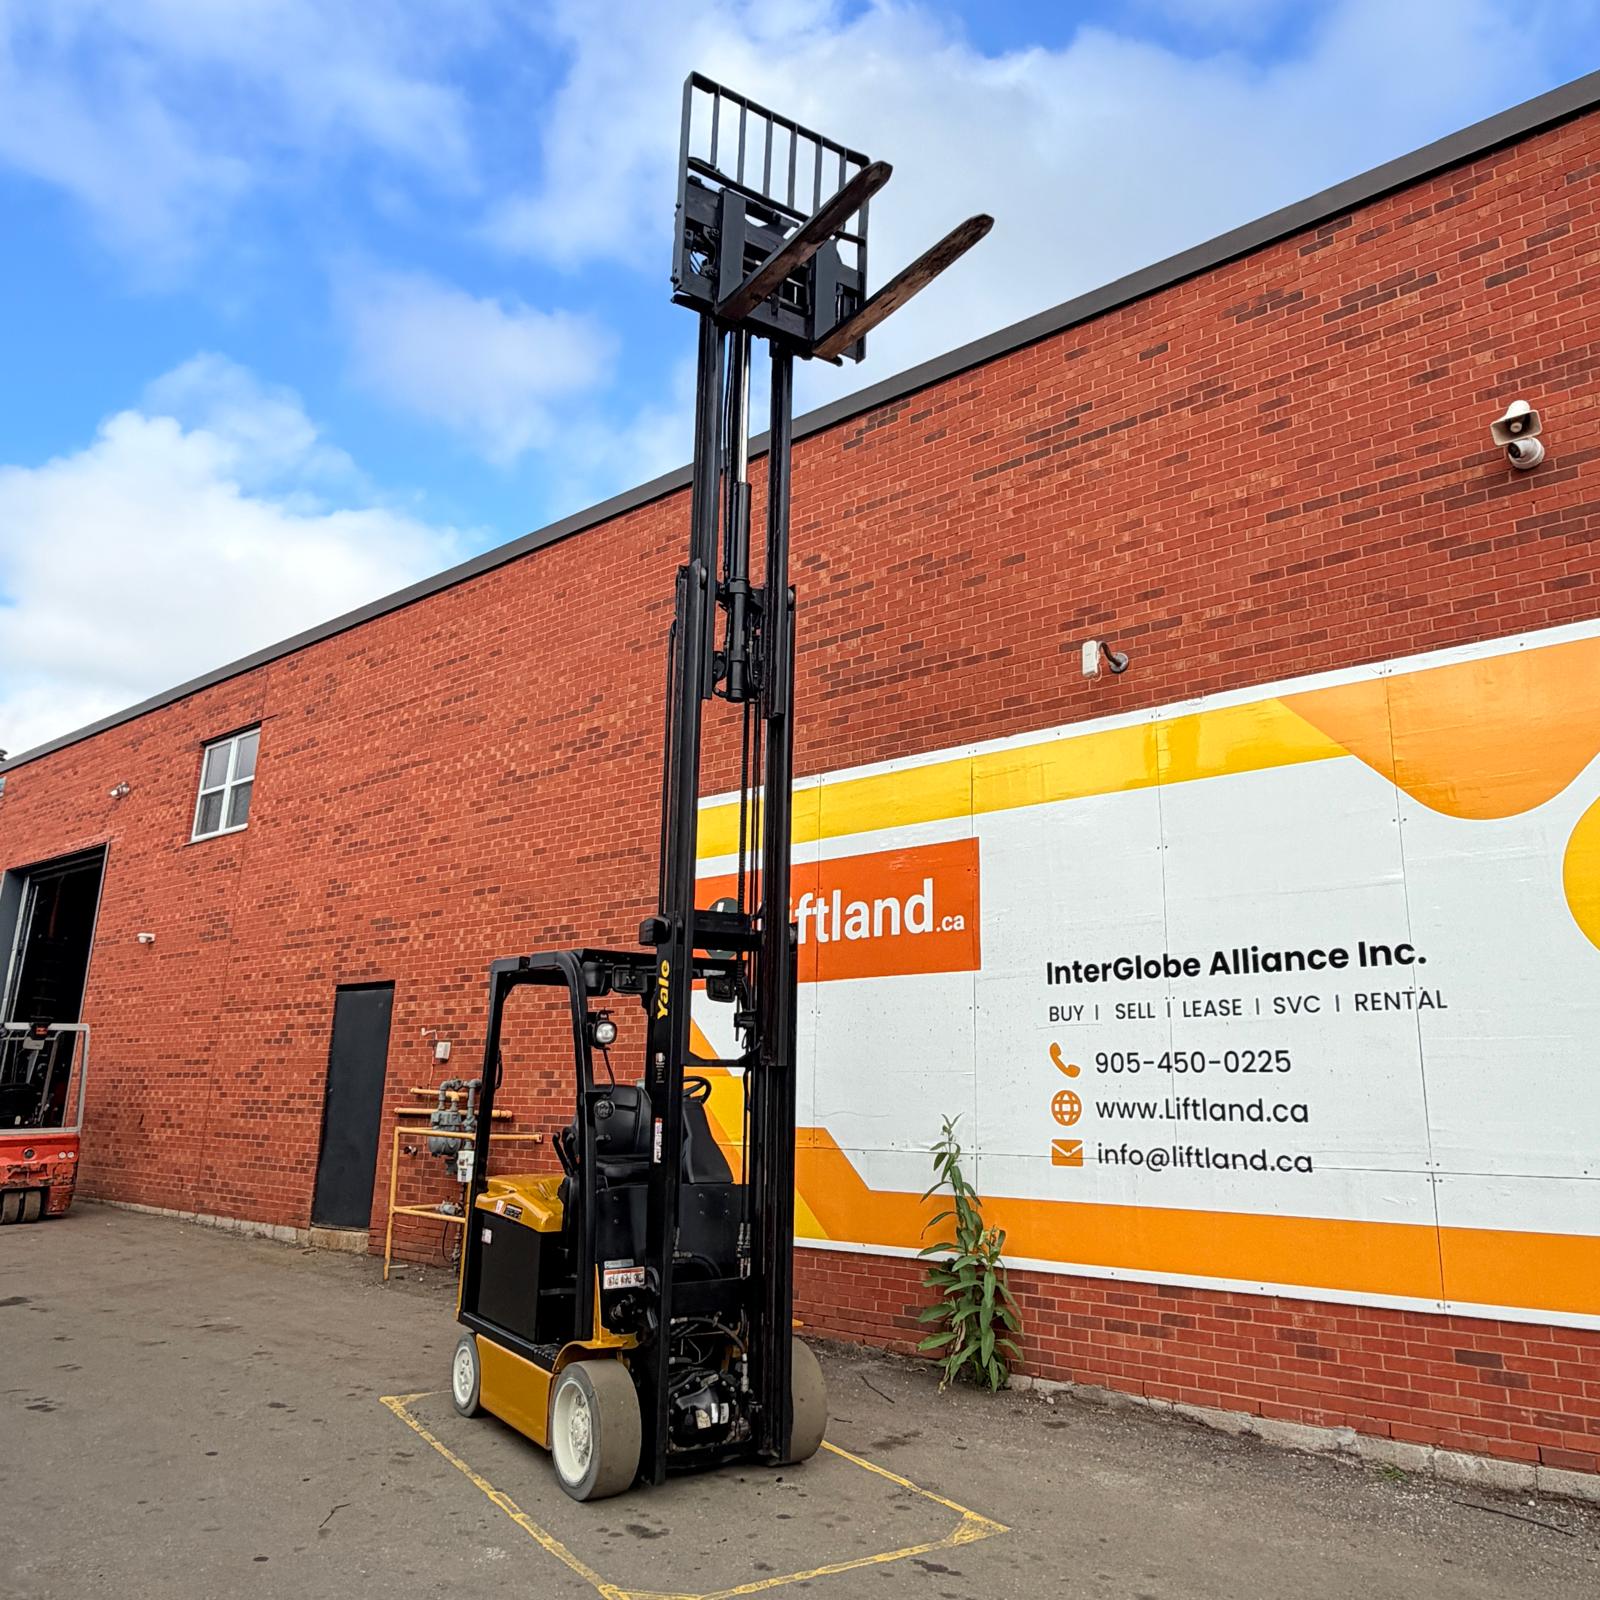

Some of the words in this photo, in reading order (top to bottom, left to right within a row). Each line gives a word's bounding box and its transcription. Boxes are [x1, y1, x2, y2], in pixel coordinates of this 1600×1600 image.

[1046, 953, 1201, 985] InterGlobe
[1209, 945, 1349, 976] Alliance
[1358, 941, 1427, 969] Inc.
[657, 959, 670, 1019] Yale
[1049, 1005, 1084, 1022] BUY
[1115, 1002, 1156, 1020] SELL
[1182, 999, 1242, 1018] LEASE
[1273, 995, 1321, 1015] SVC
[1354, 989, 1448, 1012] RENTAL
[1095, 1049, 1291, 1074] 905-450-0225
[1095, 1097, 1309, 1123] www.Liftland.ca
[1097, 1143, 1313, 1173] info@liftland.ca
